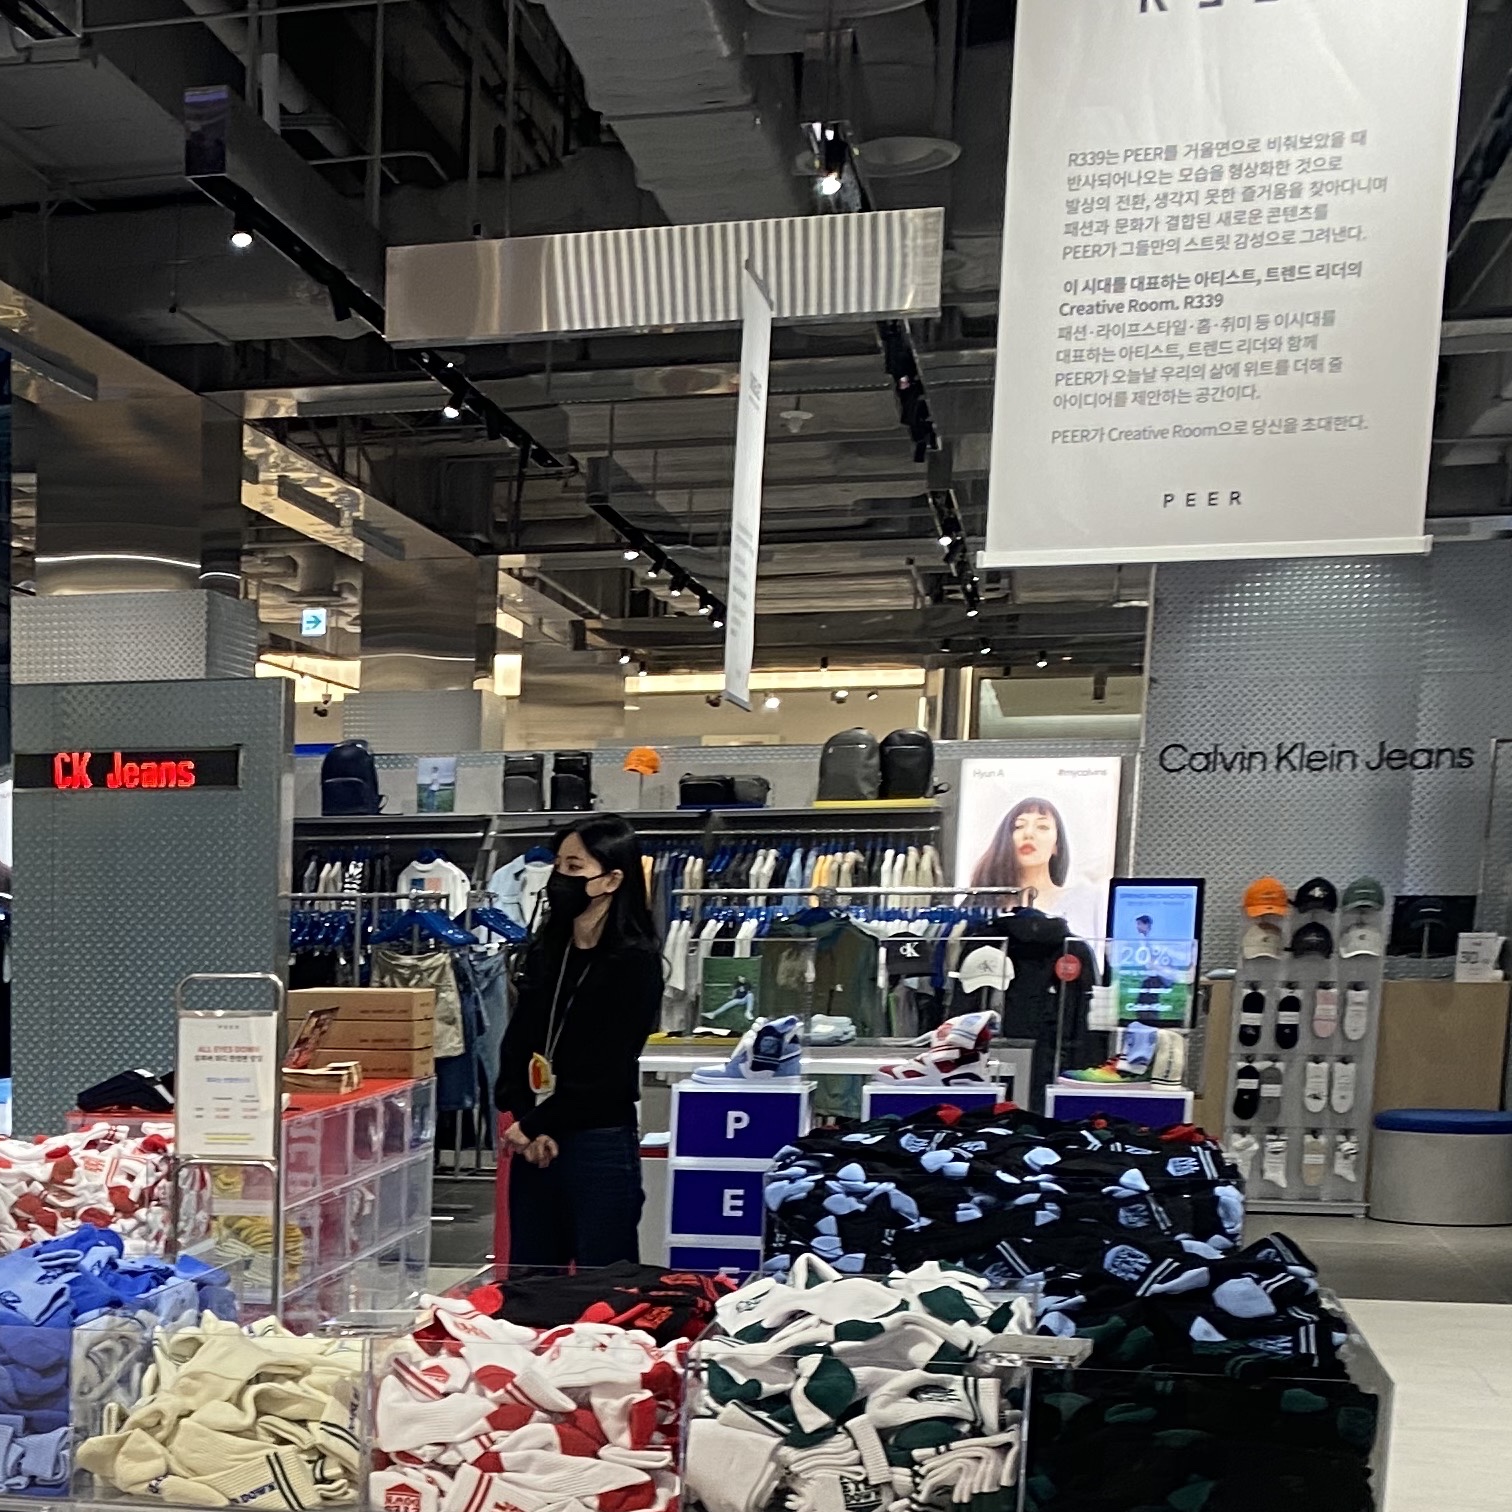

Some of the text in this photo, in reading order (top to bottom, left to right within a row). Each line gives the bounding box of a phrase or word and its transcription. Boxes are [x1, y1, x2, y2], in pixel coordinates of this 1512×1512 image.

[1068, 149, 1119, 168] R339는
[1123, 144, 1177, 164] PEER를
[1183, 138, 1260, 159] 거울면으로
[1067, 155, 1342, 192] 반사되어나오는 모습을 형상화한 것으로
[1066, 175, 1388, 215] 발상의 전환, 생각지 못한 즐거움을 찾아다니며
[1063, 219, 1108, 238] 패션과
[1115, 215, 1159, 234] 문화가
[1165, 212, 1210, 230] 결합된
[1216, 208, 1262, 227] 새로운
[1062, 225, 1366, 260] PEER가 그들만의 스트릿 감성으로 그려낸다.
[1063, 261, 1361, 296] 이 시대를 대표하는 아티스트, 트렌드 리더의
[1059, 293, 1223, 318] Creative Room. R339
[1255, 314, 1269, 330] 등
[1274, 309, 1335, 329] 이시대를
[1056, 345, 1115, 366] 대표하는
[1119, 342, 1184, 364] 아티스트,
[1236, 336, 1282, 355] 리더와
[1055, 370, 1107, 388] PEER가
[1111, 367, 1156, 386] 오늘날
[1160, 363, 1205, 383] 우리의
[1053, 382, 1261, 412] 아이디어를 제안하는 공간이다.
[1051, 413, 1368, 446] PEER가 Creative Room으로 당신을 초대한다.
[52, 750, 197, 790] CK Jeans
[1159, 740, 1474, 774] Calvin Klein Jeans
[1120, 946, 1171, 966] 20%
